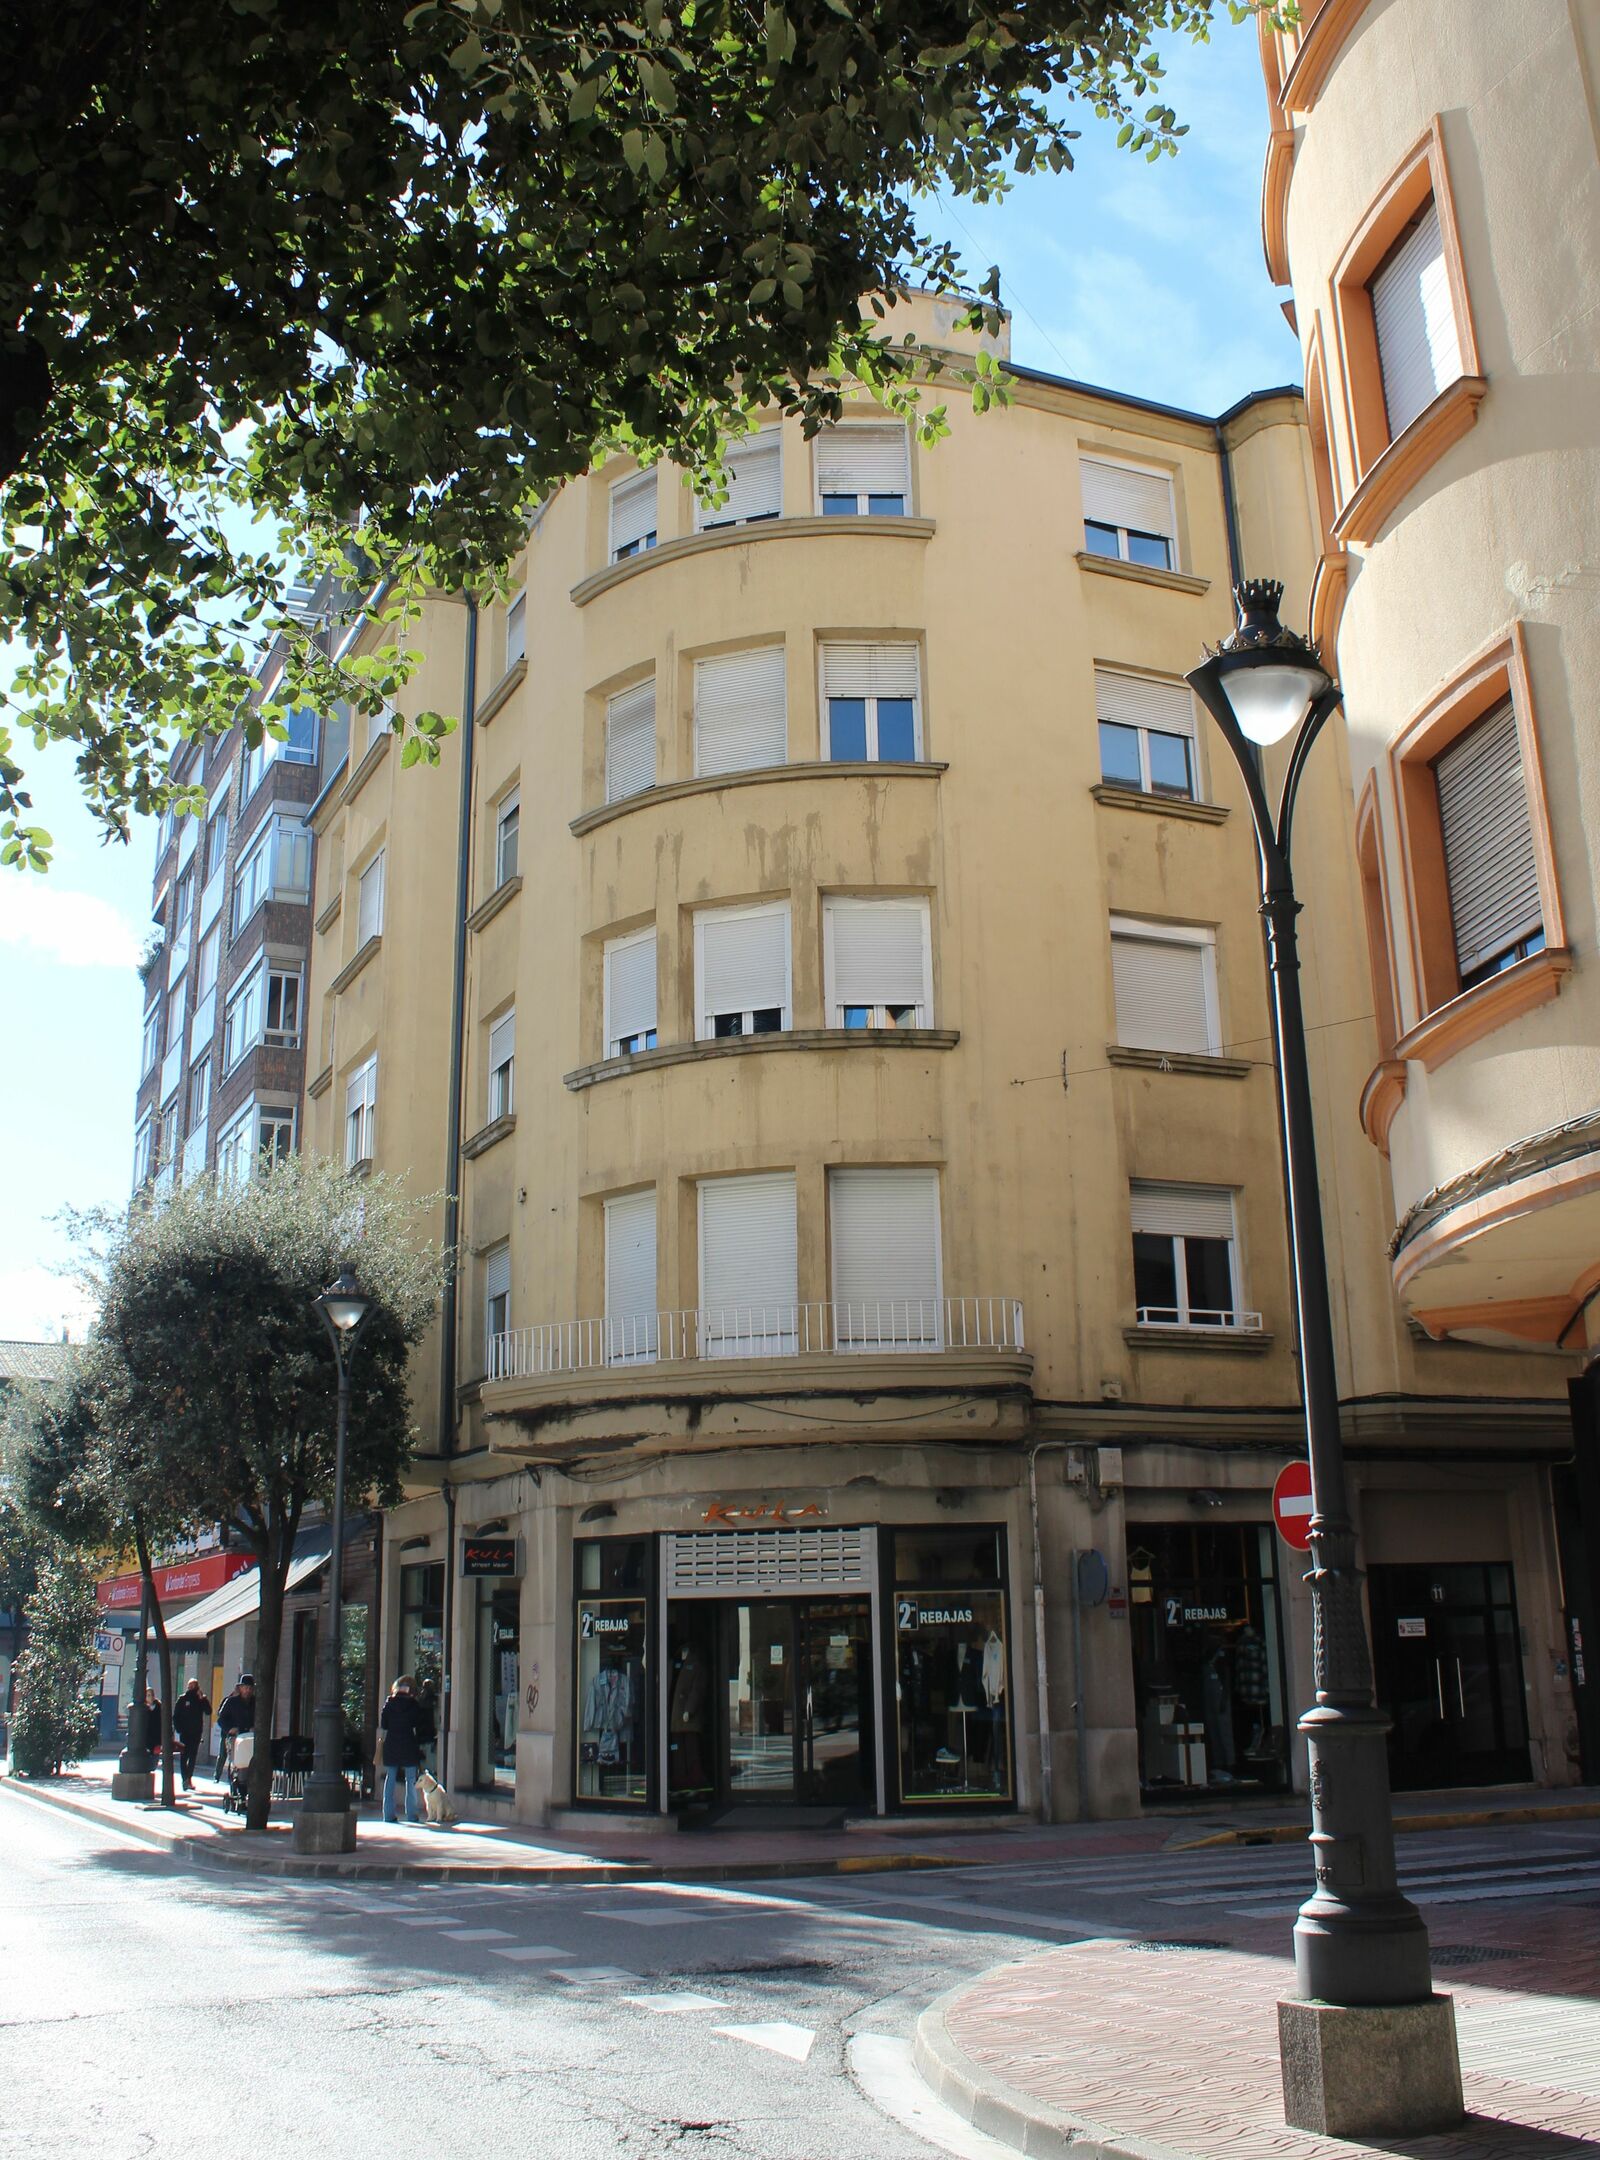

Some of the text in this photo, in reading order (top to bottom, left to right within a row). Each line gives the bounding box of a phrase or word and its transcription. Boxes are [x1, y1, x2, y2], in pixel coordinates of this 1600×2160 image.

[920, 1609, 972, 1624] REBAJAS
[1184, 1607, 1227, 1620] REBAJAS
[595, 1618, 629, 1632] REBAJAS
